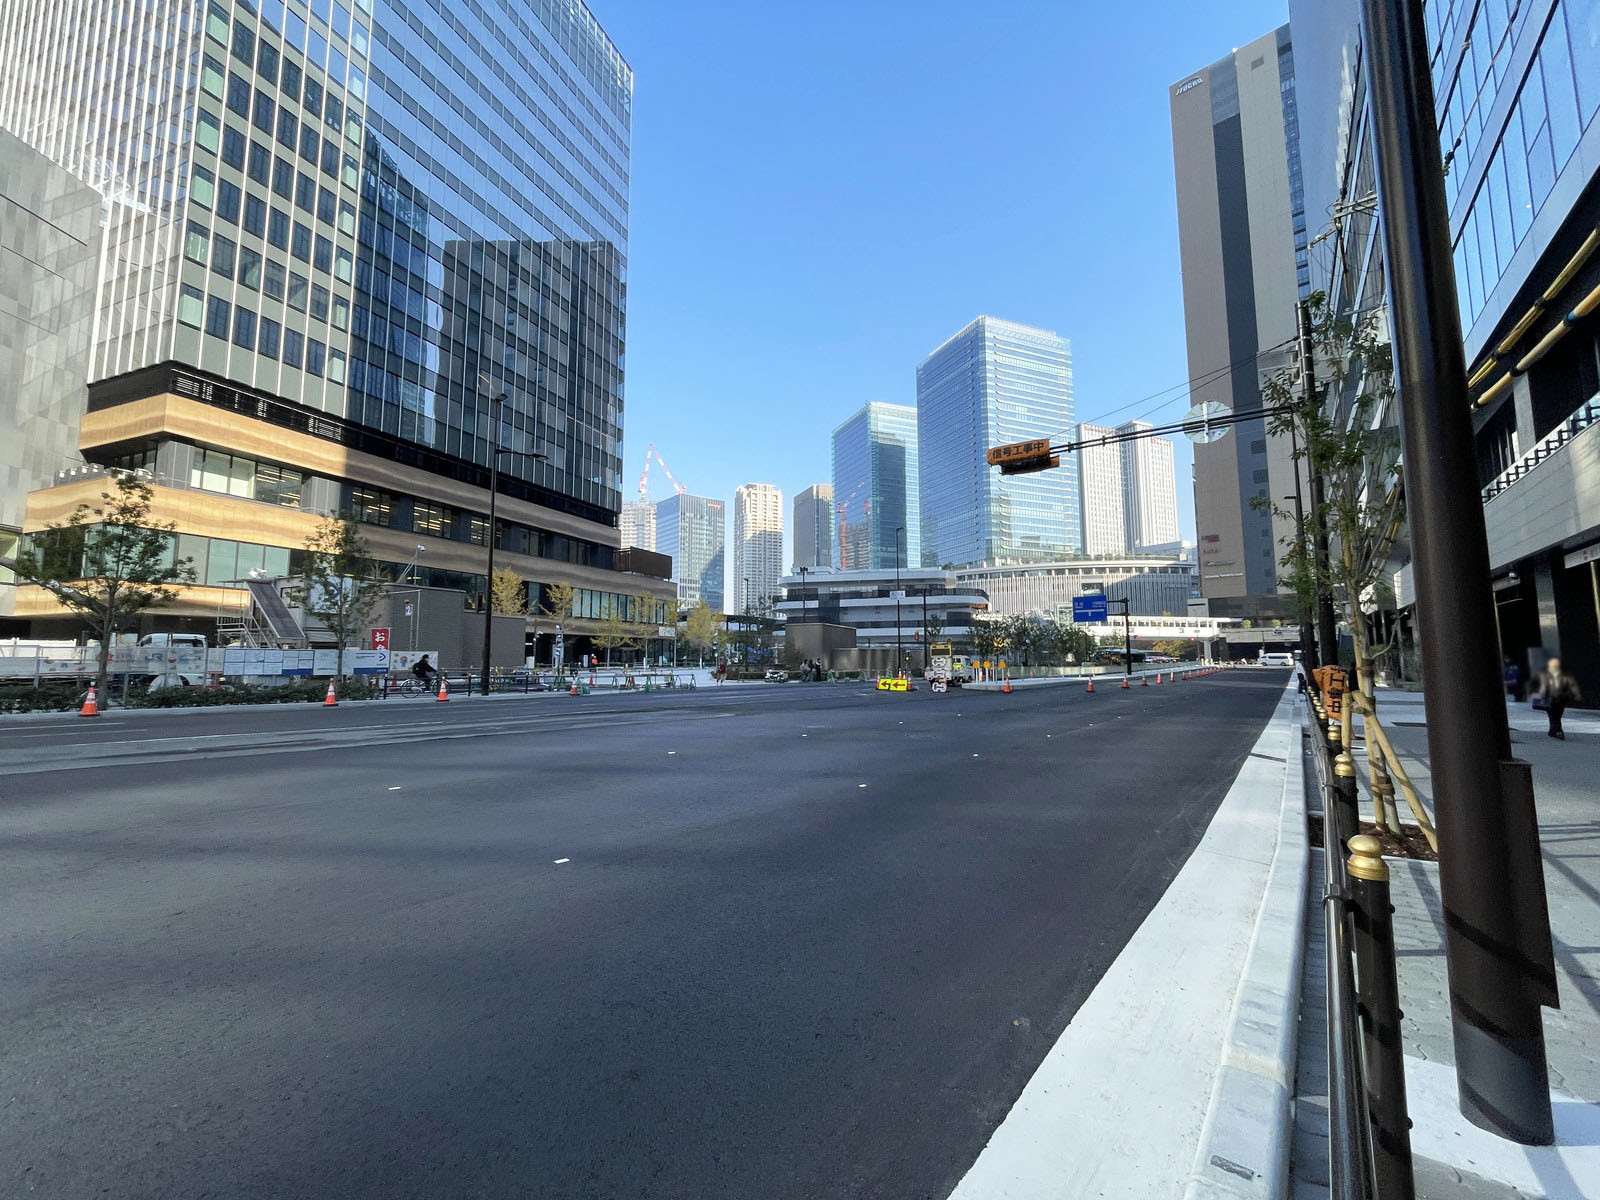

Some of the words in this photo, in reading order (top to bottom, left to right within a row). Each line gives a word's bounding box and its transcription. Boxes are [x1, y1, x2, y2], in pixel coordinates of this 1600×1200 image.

[992, 442, 1045, 459] 信号工事中
